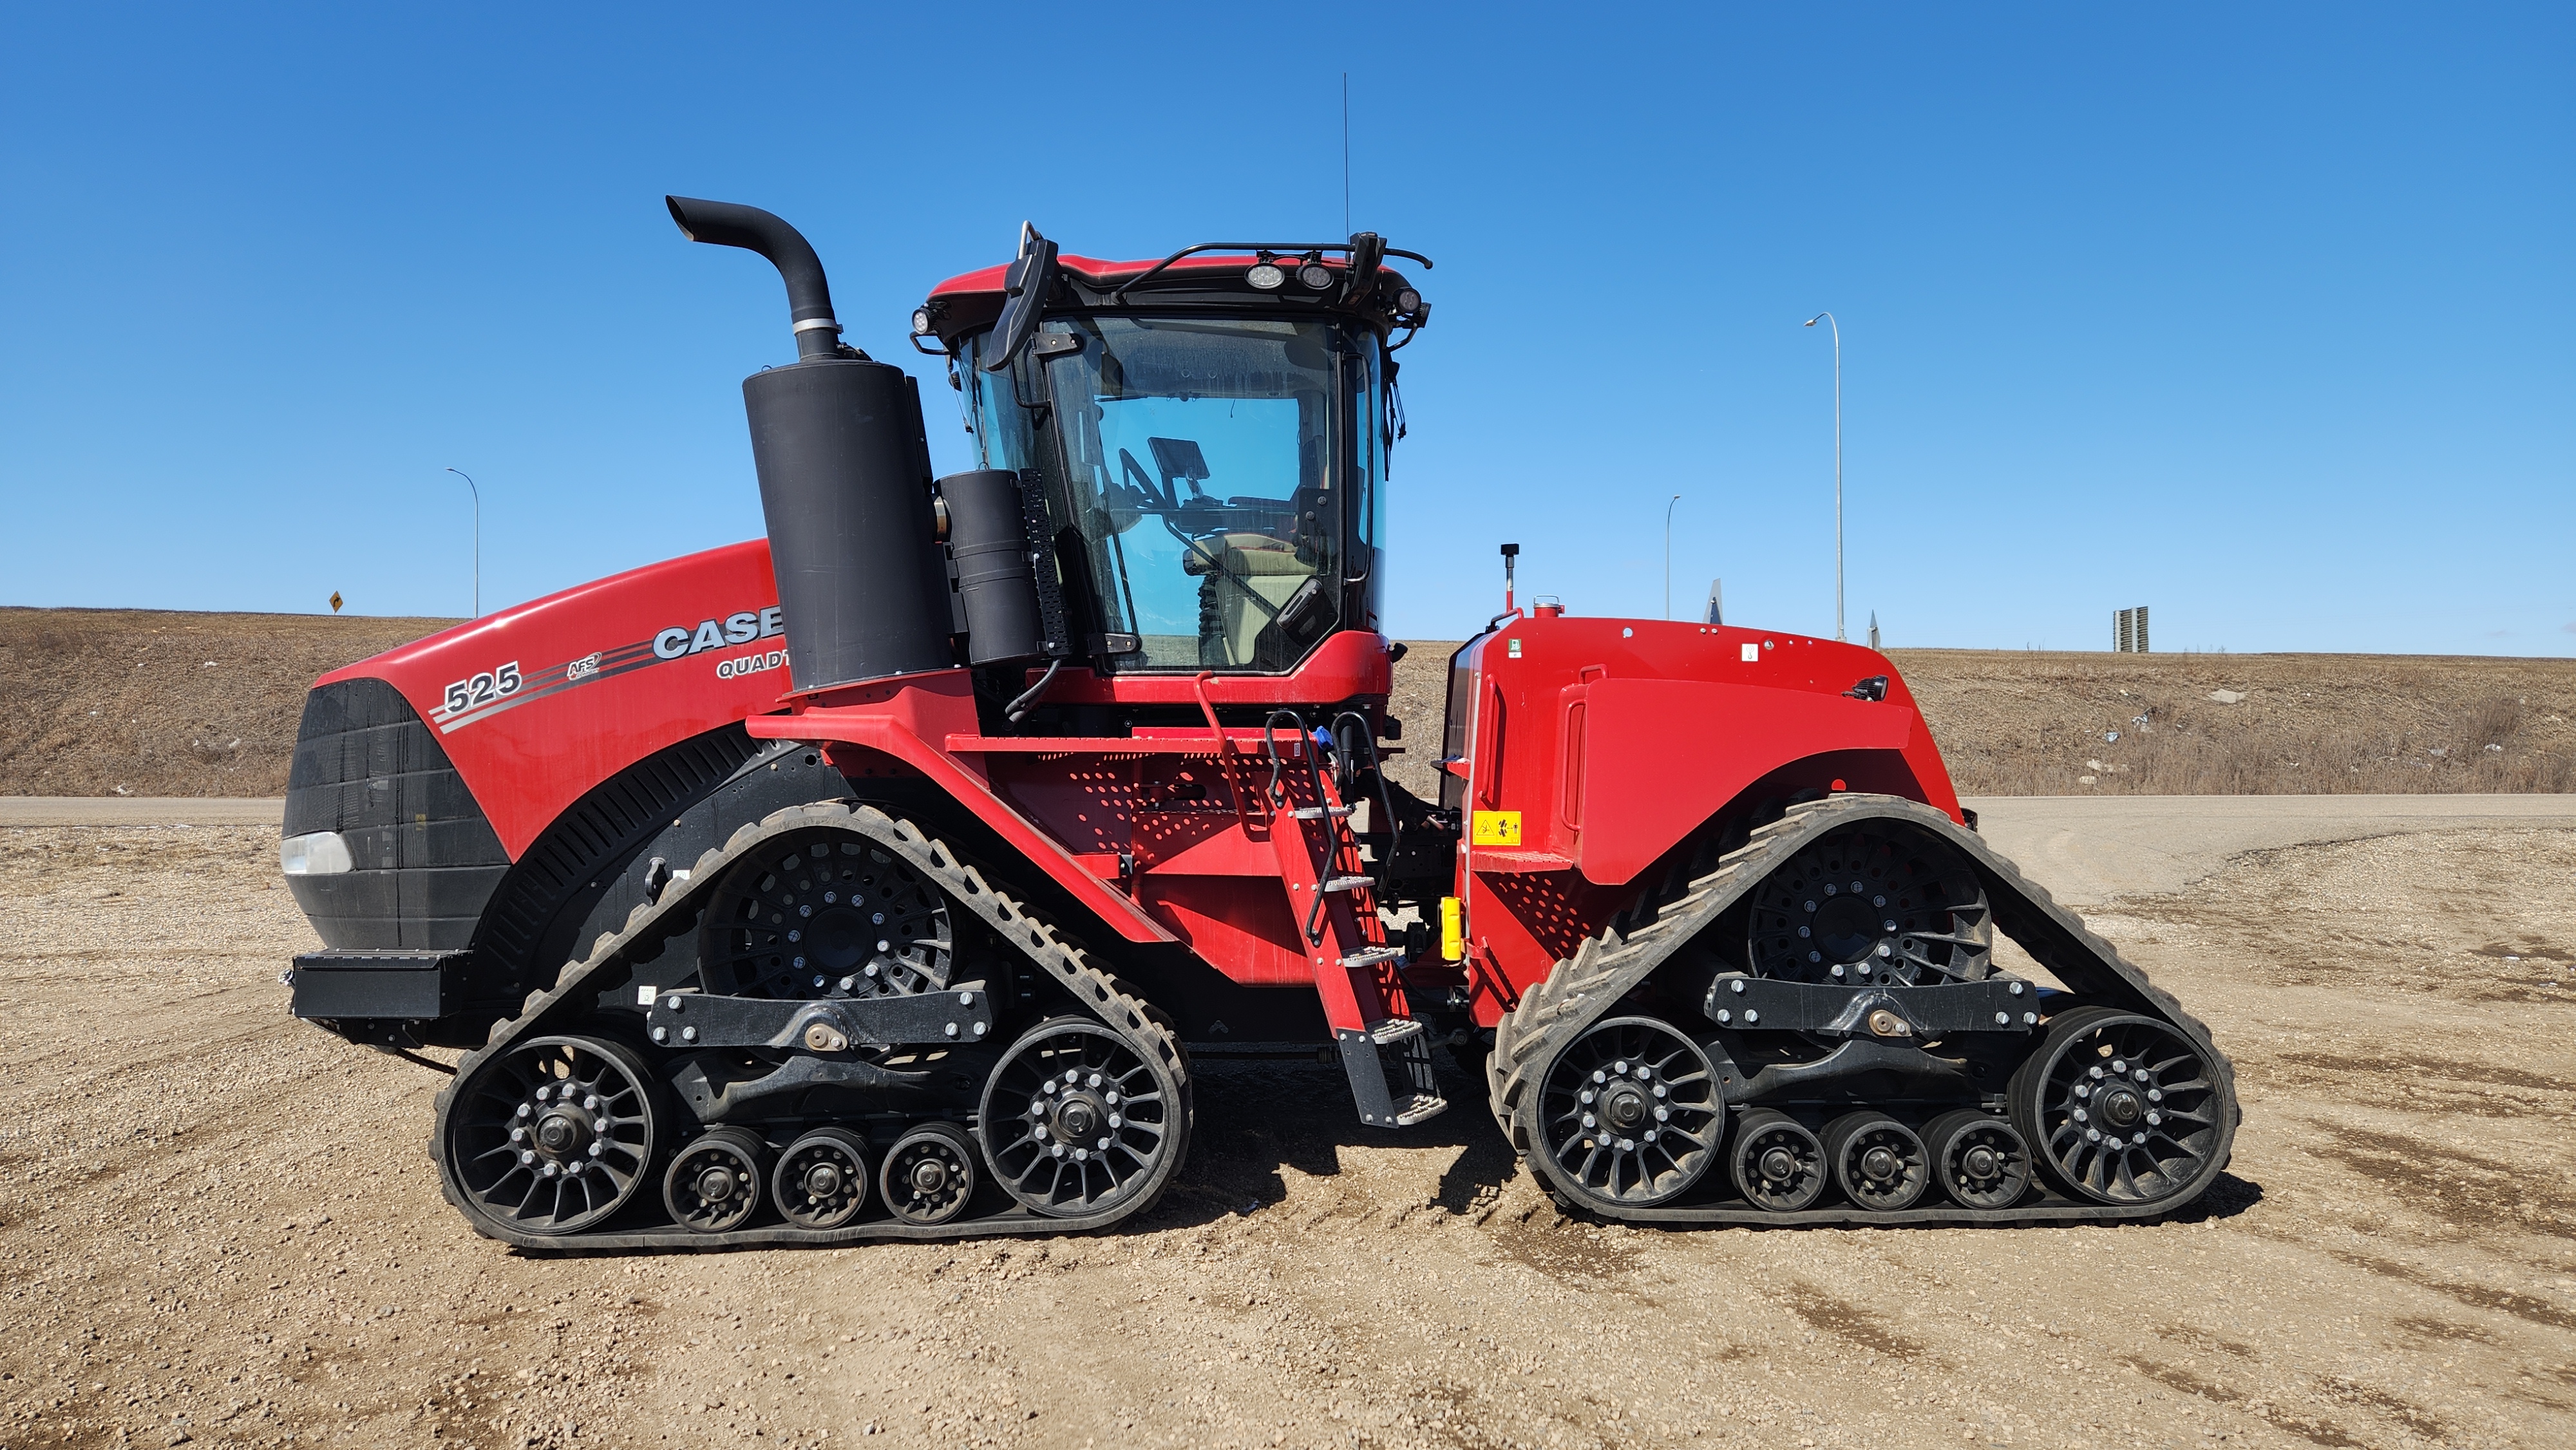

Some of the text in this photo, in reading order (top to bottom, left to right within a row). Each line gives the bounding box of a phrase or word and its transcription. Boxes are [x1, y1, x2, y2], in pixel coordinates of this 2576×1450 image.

[652, 605, 785, 661] CASE
[444, 661, 522, 714] 525
[567, 656, 595, 677] AFS
